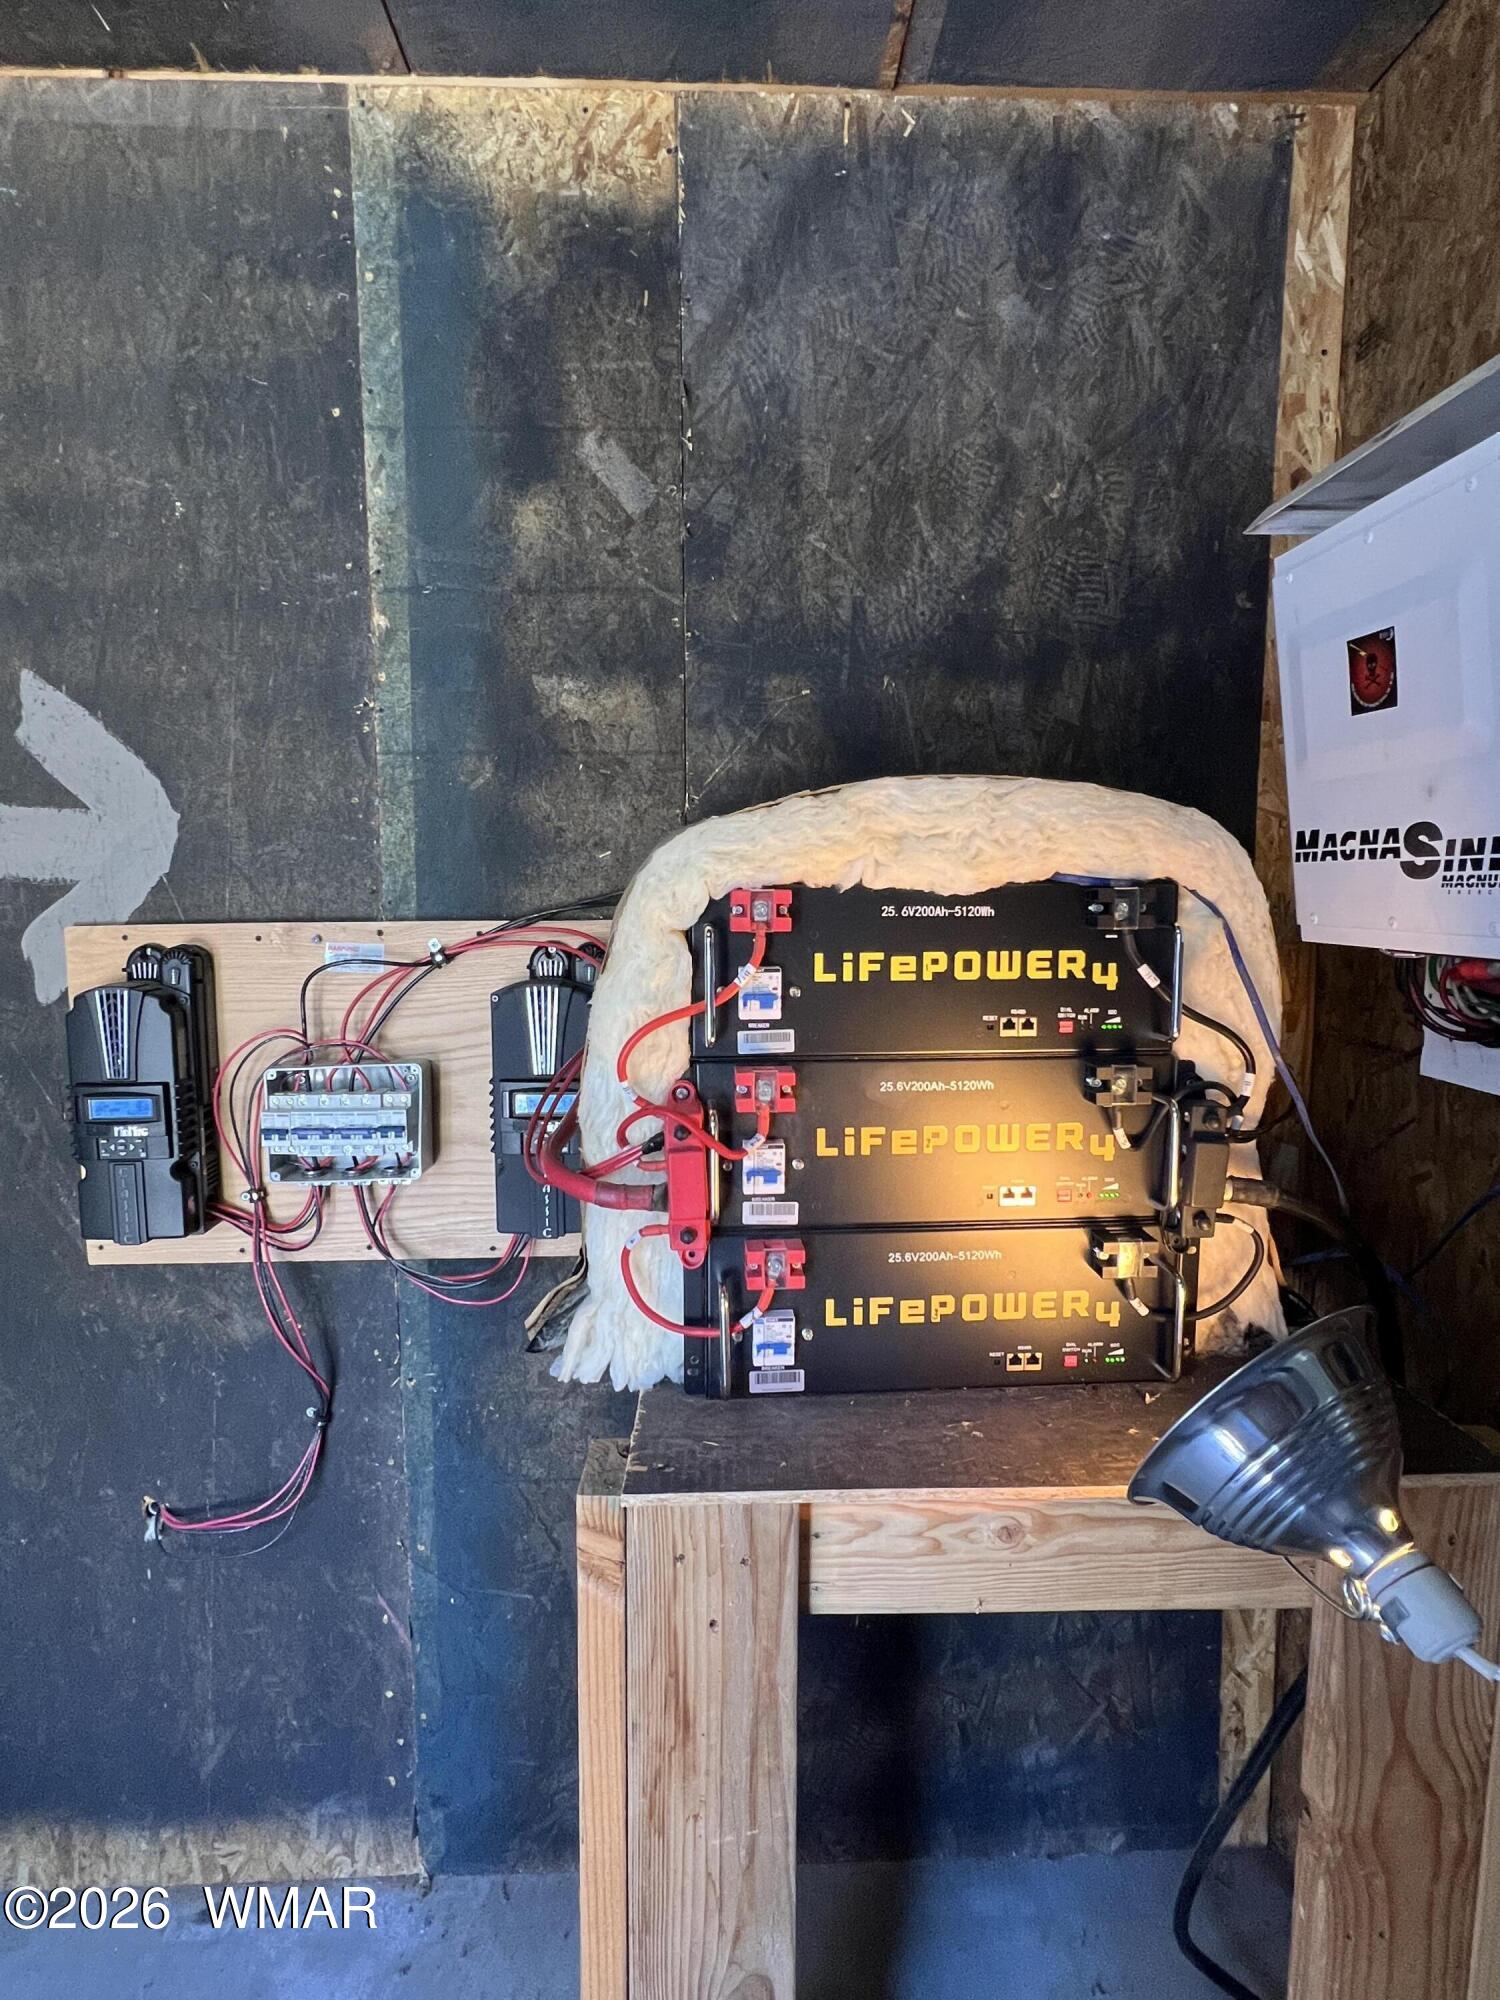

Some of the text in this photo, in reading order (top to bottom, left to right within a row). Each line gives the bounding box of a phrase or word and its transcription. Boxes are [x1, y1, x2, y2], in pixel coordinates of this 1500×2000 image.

[1441, 873, 1500, 888] MAGNU
[879, 1080, 994, 1093] 25.6V200Ah-5120Wh
[887, 1250, 1002, 1264] 25.6V200Ah-5120Wh
